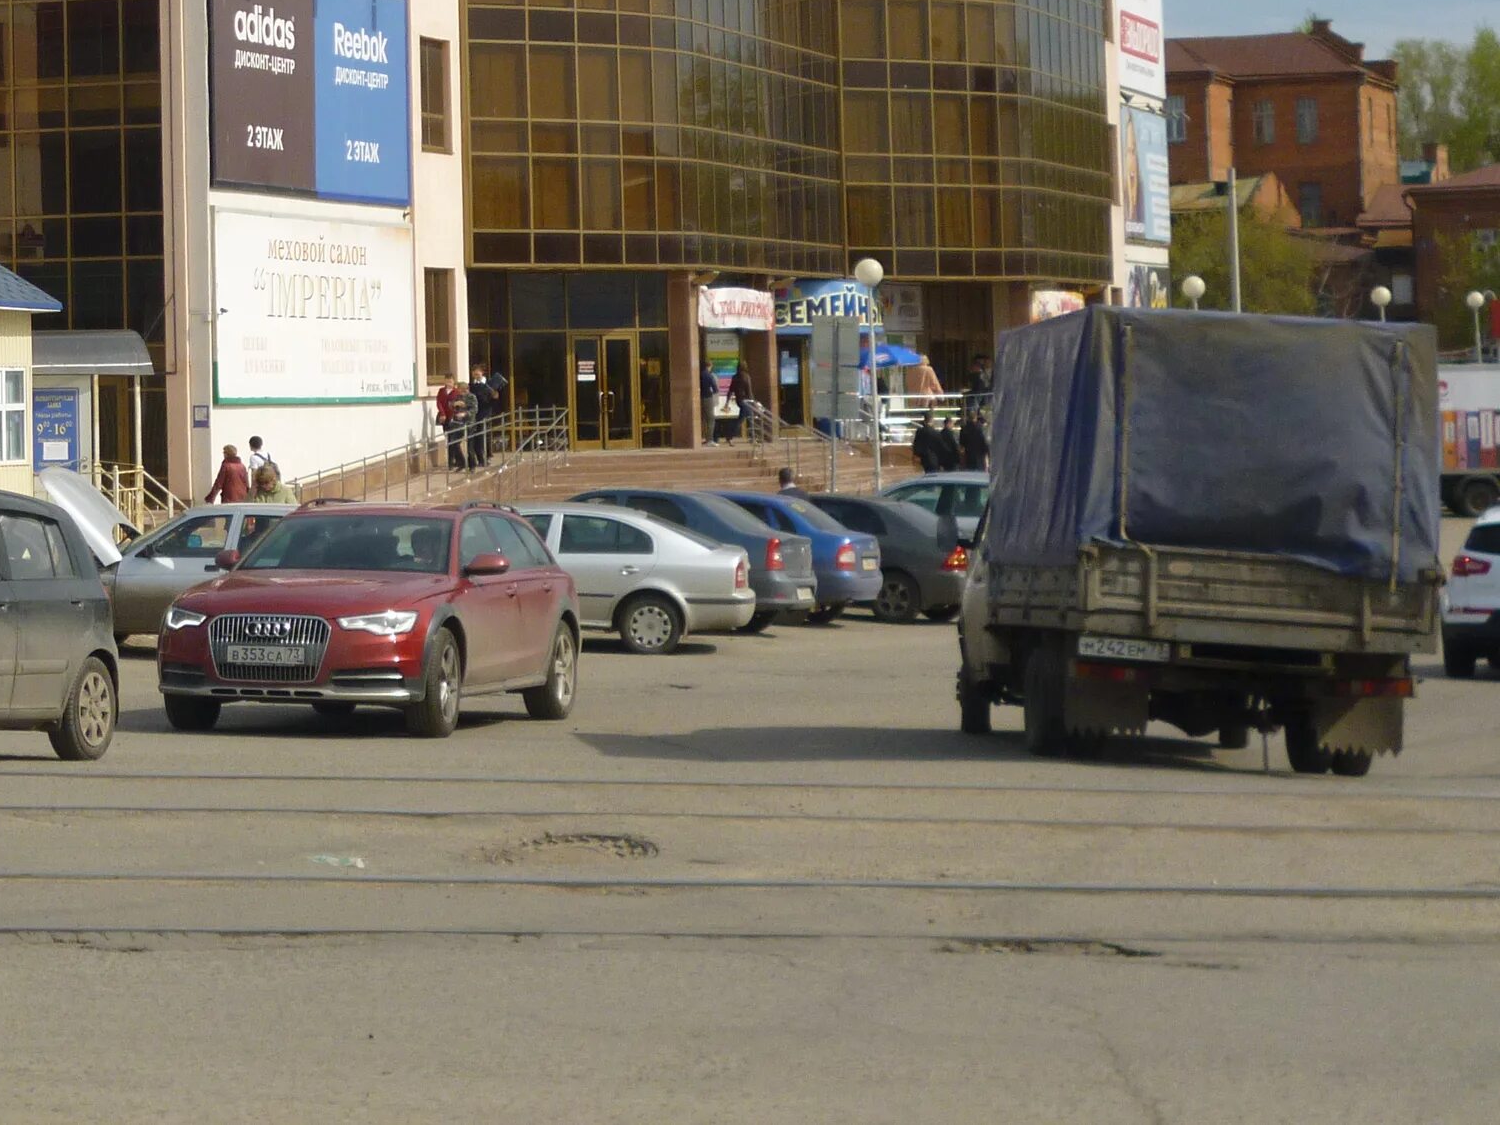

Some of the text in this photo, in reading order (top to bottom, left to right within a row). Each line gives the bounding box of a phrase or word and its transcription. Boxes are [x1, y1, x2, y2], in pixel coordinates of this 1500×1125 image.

[233, 5, 296, 50] adidas
[334, 22, 389, 64] Reebok
[234, 50, 296, 75] ДИСКОНТ-ЦЕНТР
[335, 67, 389, 91] ДИСКОНТ-ЦЕНТР
[247, 125, 284, 151] 2 ЭТАЖ
[346, 140, 380, 164] 2 ЭТАЖ
[267, 234, 368, 266] меховой салон
